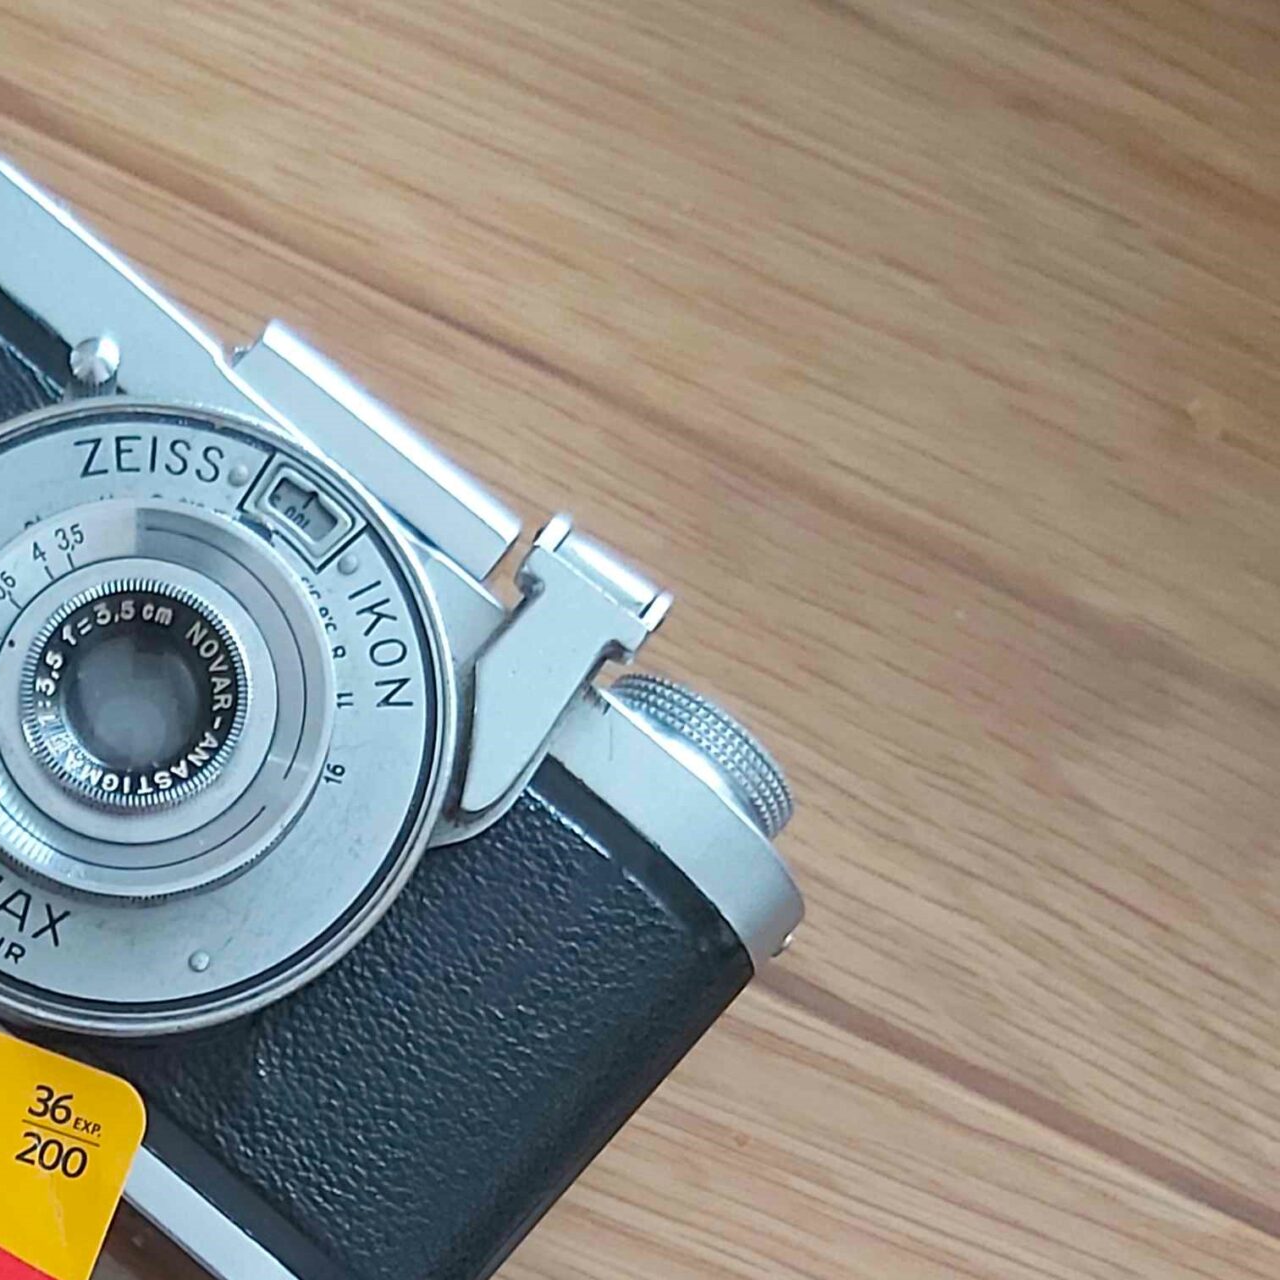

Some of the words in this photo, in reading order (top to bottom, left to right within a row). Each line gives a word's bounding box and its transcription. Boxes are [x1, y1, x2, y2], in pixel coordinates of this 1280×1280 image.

[31, 541, 47, 562] 4
[74, 436, 224, 483] ZEISS
[348, 580, 414, 708] IKON
[324, 763, 346, 784] 16
[27, 1084, 74, 1125] 36
[73, 1117, 102, 1138] EXP.
[15, 1131, 88, 1179] 200
